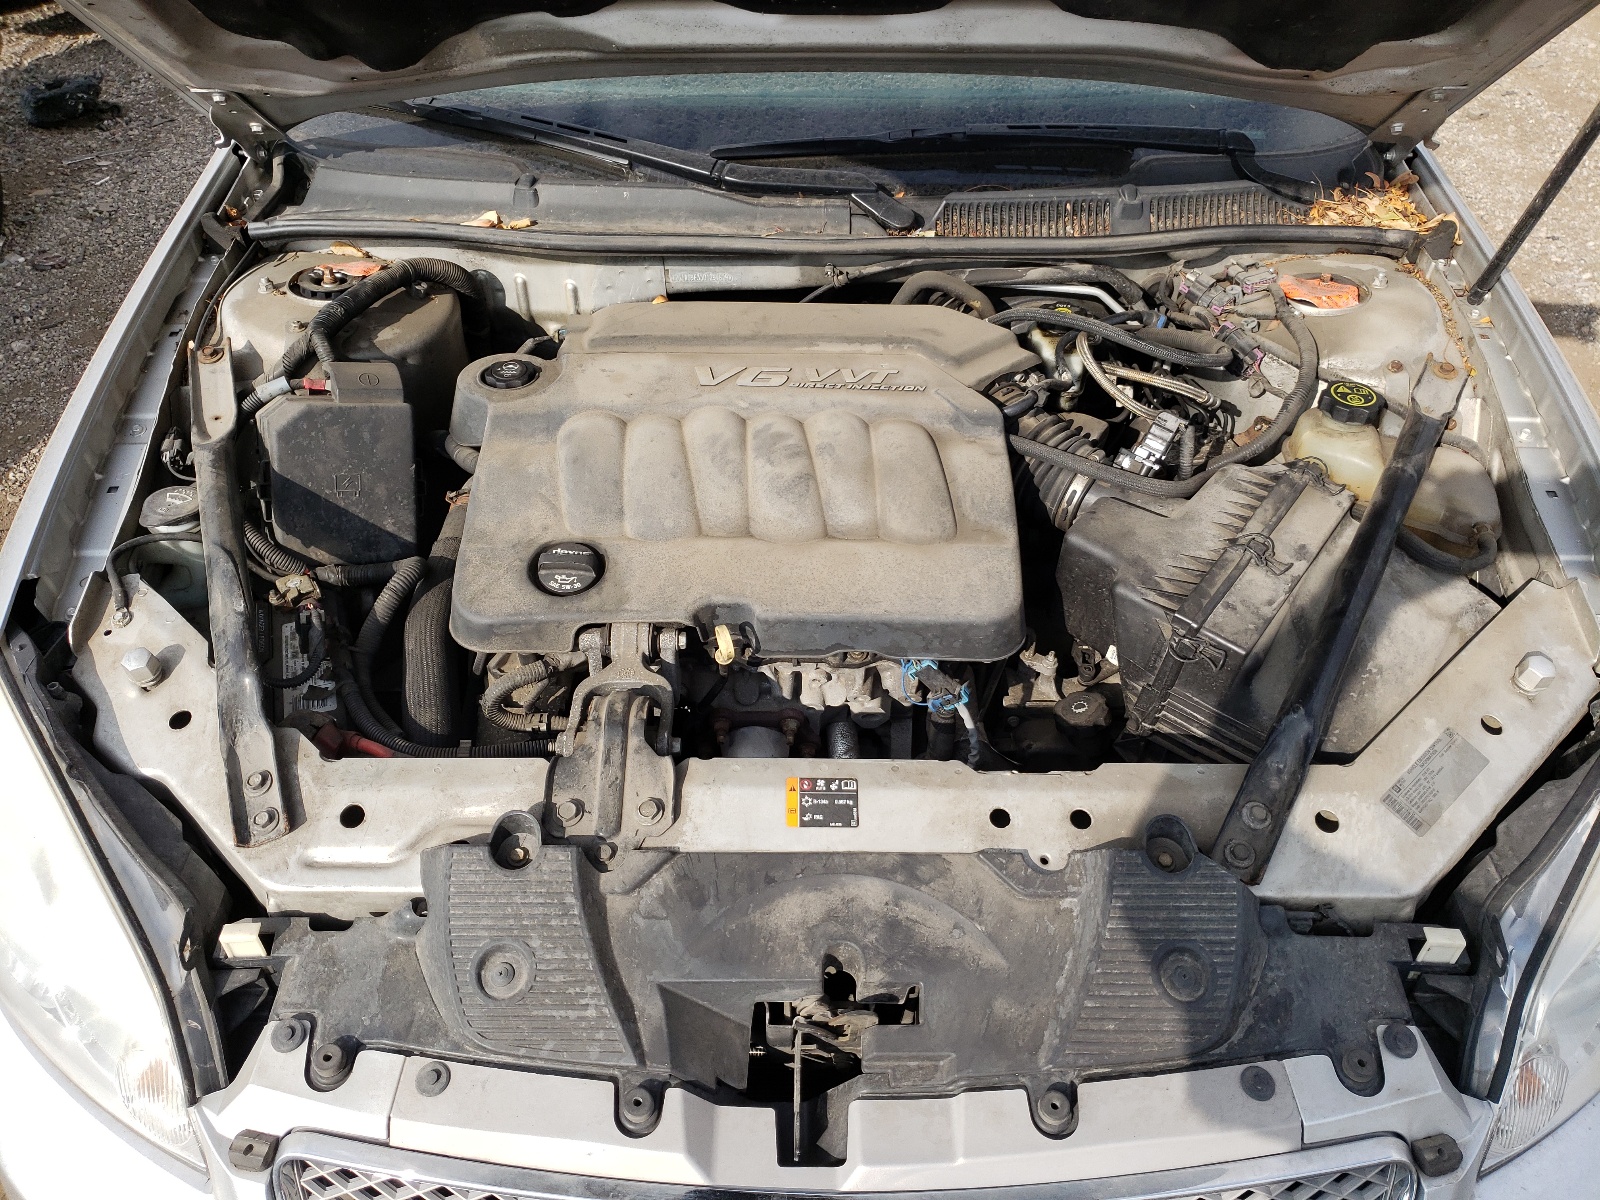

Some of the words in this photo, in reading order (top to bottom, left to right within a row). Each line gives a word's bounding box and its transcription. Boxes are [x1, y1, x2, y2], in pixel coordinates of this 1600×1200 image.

[694, 366, 793, 387] V6
[804, 368, 900, 384] VVT
[846, 383, 928, 392] INJECTION
